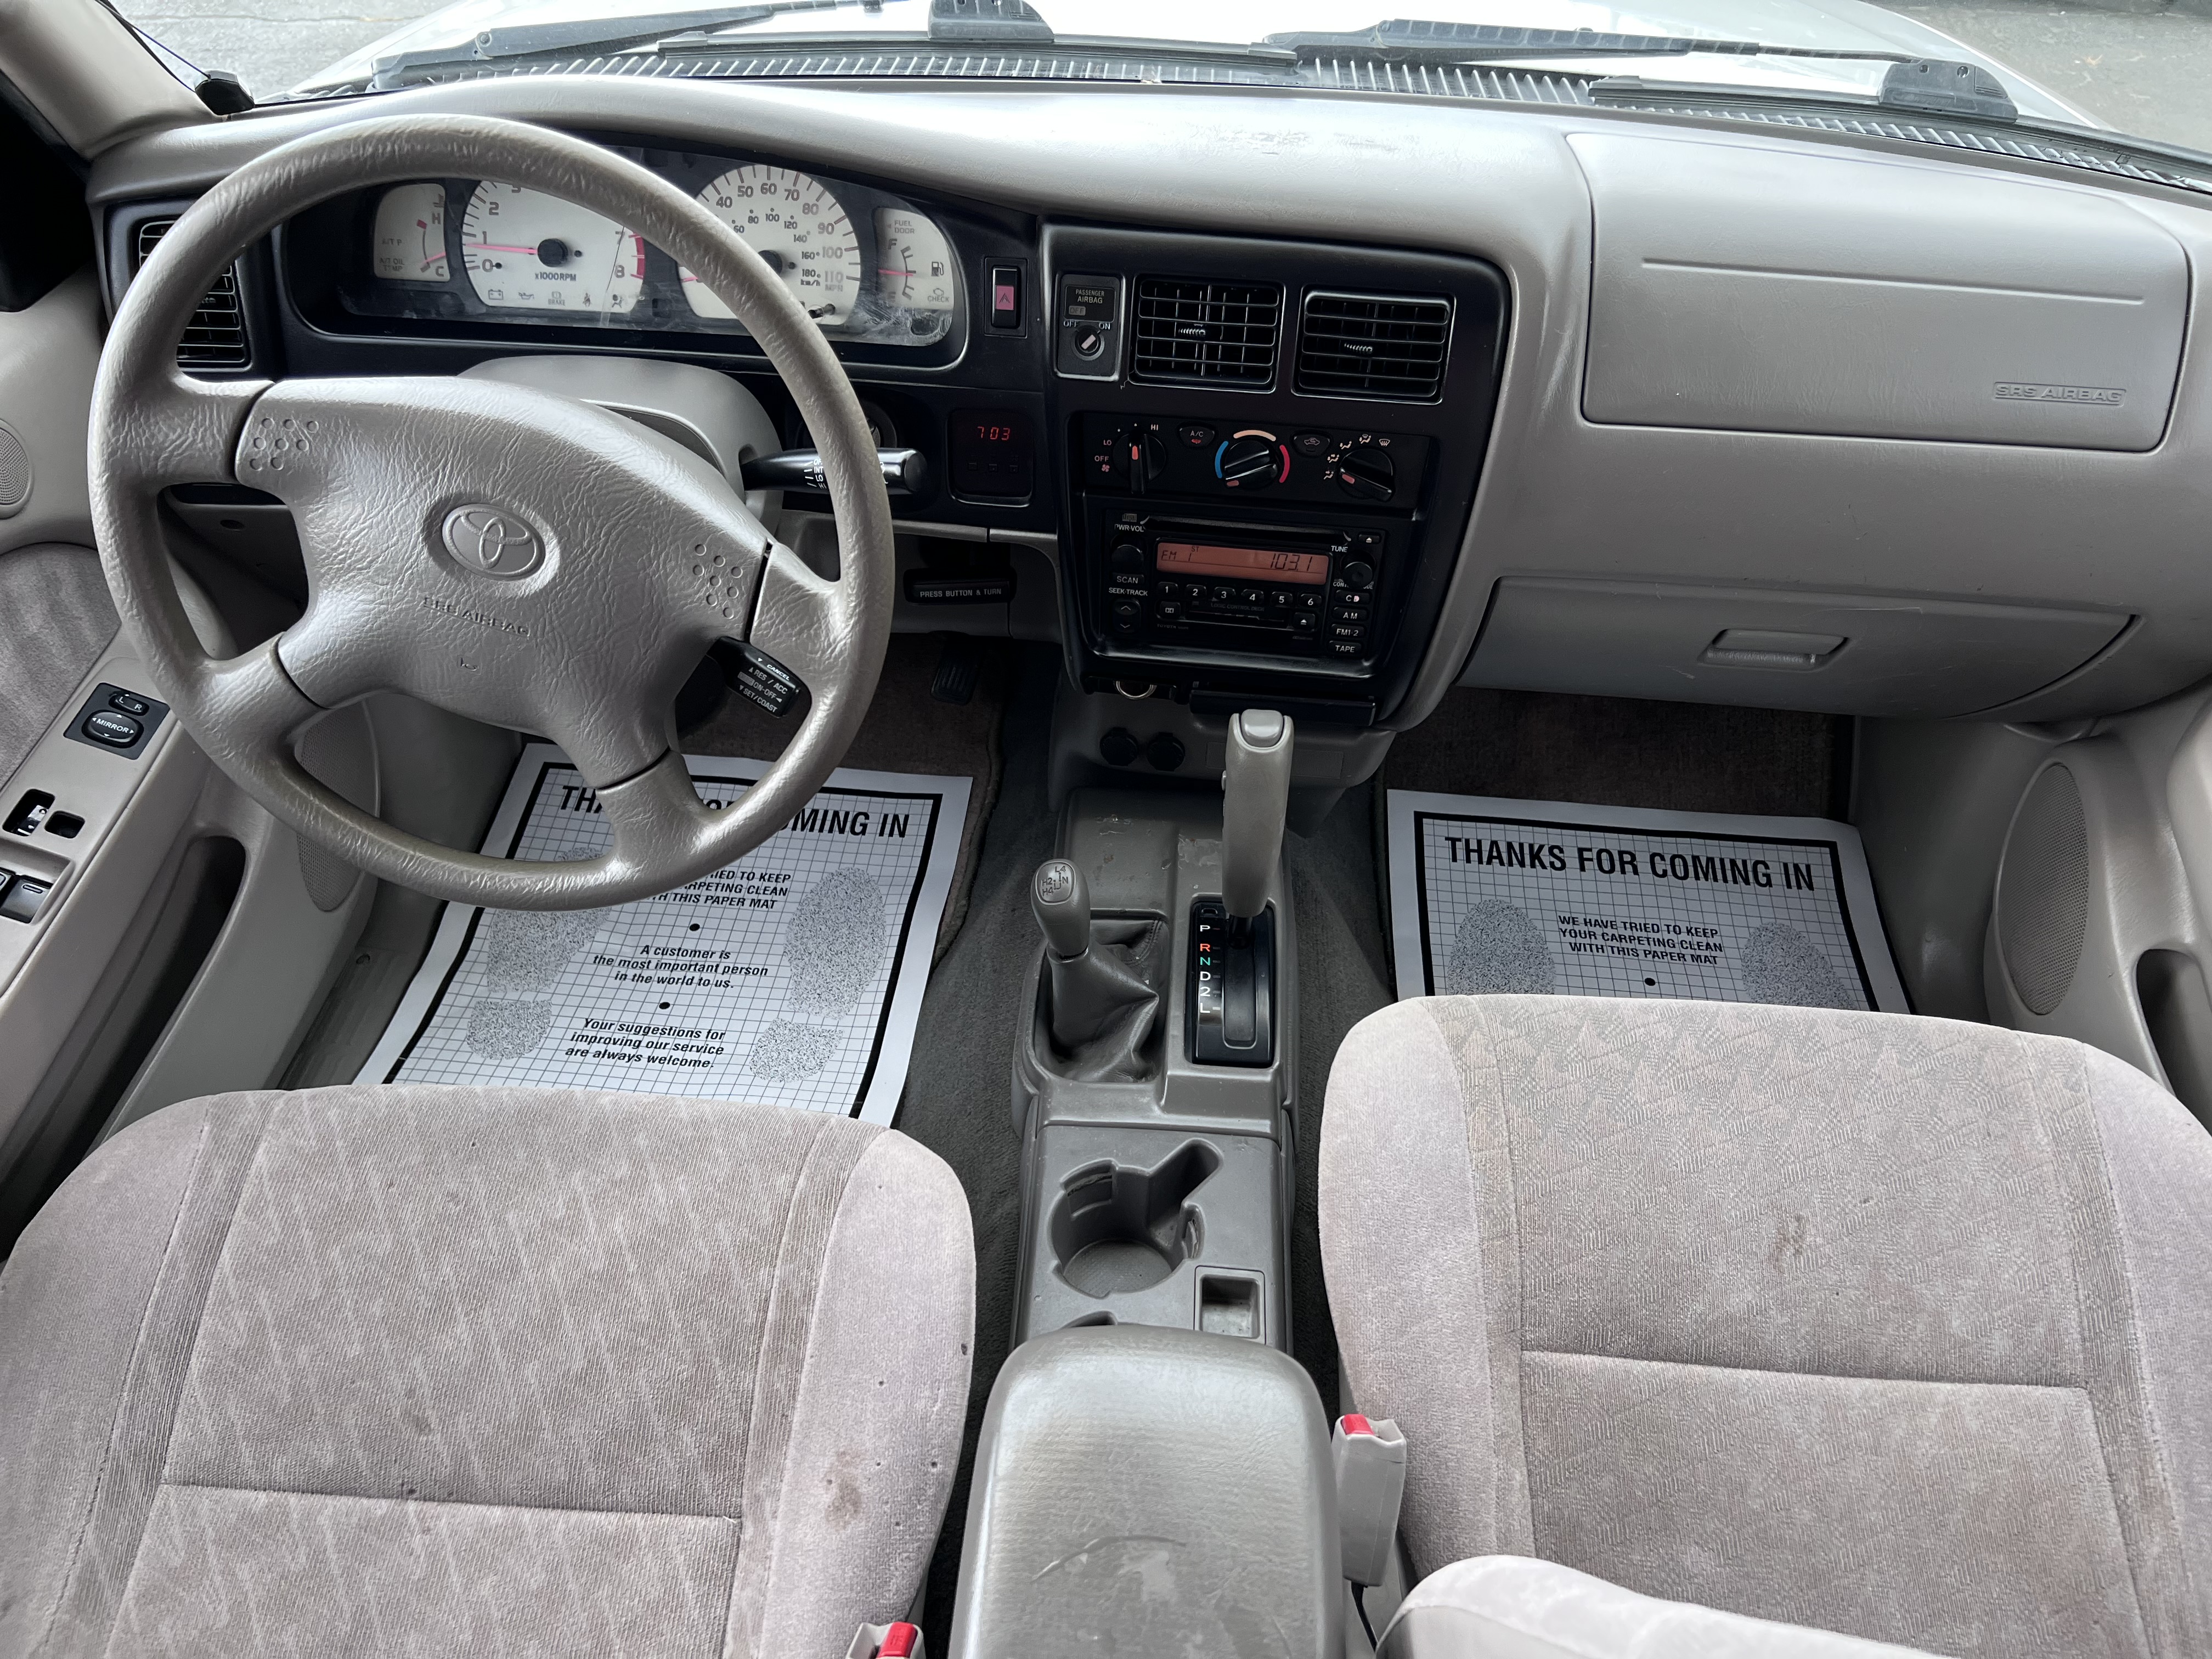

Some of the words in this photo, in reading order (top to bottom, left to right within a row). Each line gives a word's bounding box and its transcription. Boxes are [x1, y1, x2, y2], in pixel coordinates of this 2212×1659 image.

[737, 185, 754, 198] 50
[760, 183, 777, 195] 60
[784, 189, 800, 201] 70
[489, 202, 499, 215] 2
[716, 196, 732, 208] 40
[802, 203, 819, 215] 80
[432, 213, 441, 224] H
[748, 216, 759, 224] 80
[765, 214, 780, 222] 100
[733, 225, 744, 233] 60
[784, 221, 797, 229] 120
[817, 222, 834, 235] 90
[482, 231, 487, 244] 1
[793, 234, 807, 242] 140
[888, 238, 898, 250] F
[802, 251, 815, 260] 160
[822, 246, 843, 259] 100
[436, 266, 444, 277] C
[482, 259, 494, 273] 0
[614, 264, 625, 279] 8
[802, 269, 816, 278] 180
[825, 271, 844, 283] 110
[1077, 296, 1103, 304] AIRBAG
[1995, 385, 2036, 398] SRS
[2041, 386, 2122, 402] AIRBAG
[1161, 550, 1177, 561] FM
[1188, 553, 1192, 561] 1
[1192, 588, 1198, 596] 2
[462, 610, 531, 637] AIRBAG
[766, 664, 790, 681] CANCEL
[754, 669, 767, 681] RES
[773, 682, 788, 695] ACC
[753, 682, 777, 699] ON-OFF
[743, 689, 778, 713] SET/COAST
[96, 718, 129, 733] MIRROR
[780, 808, 870, 836] MING
[878, 814, 910, 838] IN
[1444, 837, 1567, 872] THANKS
[1577, 847, 1639, 876] FOR
[1649, 852, 1773, 888] COMING
[1782, 862, 1815, 891] IN
[710, 870, 736, 879] IED
[740, 871, 755, 881] TO
[759, 872, 791, 883] KEEP
[1042, 877, 1053, 887] H2
[684, 882, 743, 894] RPETING
[747, 885, 788, 896] CLEAN
[1042, 887, 1054, 896] H4
[673, 893, 701, 903] THIS
[704, 895, 746, 907] PAPER
[749, 898, 778, 909] MAT
[1558, 915, 1579, 926] WE
[1583, 918, 1617, 930] HAVE
[1621, 921, 1660, 933] TRIED
[1664, 924, 1681, 935] TO
[1685, 926, 1718, 939] KEEP
[1559, 928, 1598, 940] YOUR
[1601, 932, 1675, 949] CARPETING
[1680, 940, 1723, 952] CLEAN
[640, 945, 650, 955] A
[653, 946, 715, 960] customer
[719, 949, 731, 960] is
[1200, 943, 1211, 952] R
[1569, 942, 1605, 953] WITH
[1607, 945, 1639, 957] THIS
[1643, 950, 1686, 962] PAPER
[1690, 953, 1718, 965] MAT
[593, 954, 614, 967] the
[618, 958, 653, 970] most
[654, 959, 719, 973] important
[721, 965, 769, 977] person
[1200, 957, 1211, 966] N
[614, 970, 628, 981] in
[631, 973, 652, 984] the
[657, 975, 695, 986] world
[698, 977, 712, 988] to
[714, 979, 734, 989] us.
[1200, 971, 1211, 981] D
[1200, 986, 1211, 997] 2
[1200, 1002, 1211, 1013] L
[584, 1018, 616, 1031] Your
[618, 1022, 702, 1039] suggestions
[706, 1029, 726, 1040] for
[571, 1031, 641, 1049] improving
[646, 1040, 670, 1050] our
[673, 1043, 724, 1056] service
[565, 1047, 589, 1058] are
[593, 1048, 643, 1063] always
[647, 1053, 714, 1068] welcome.
